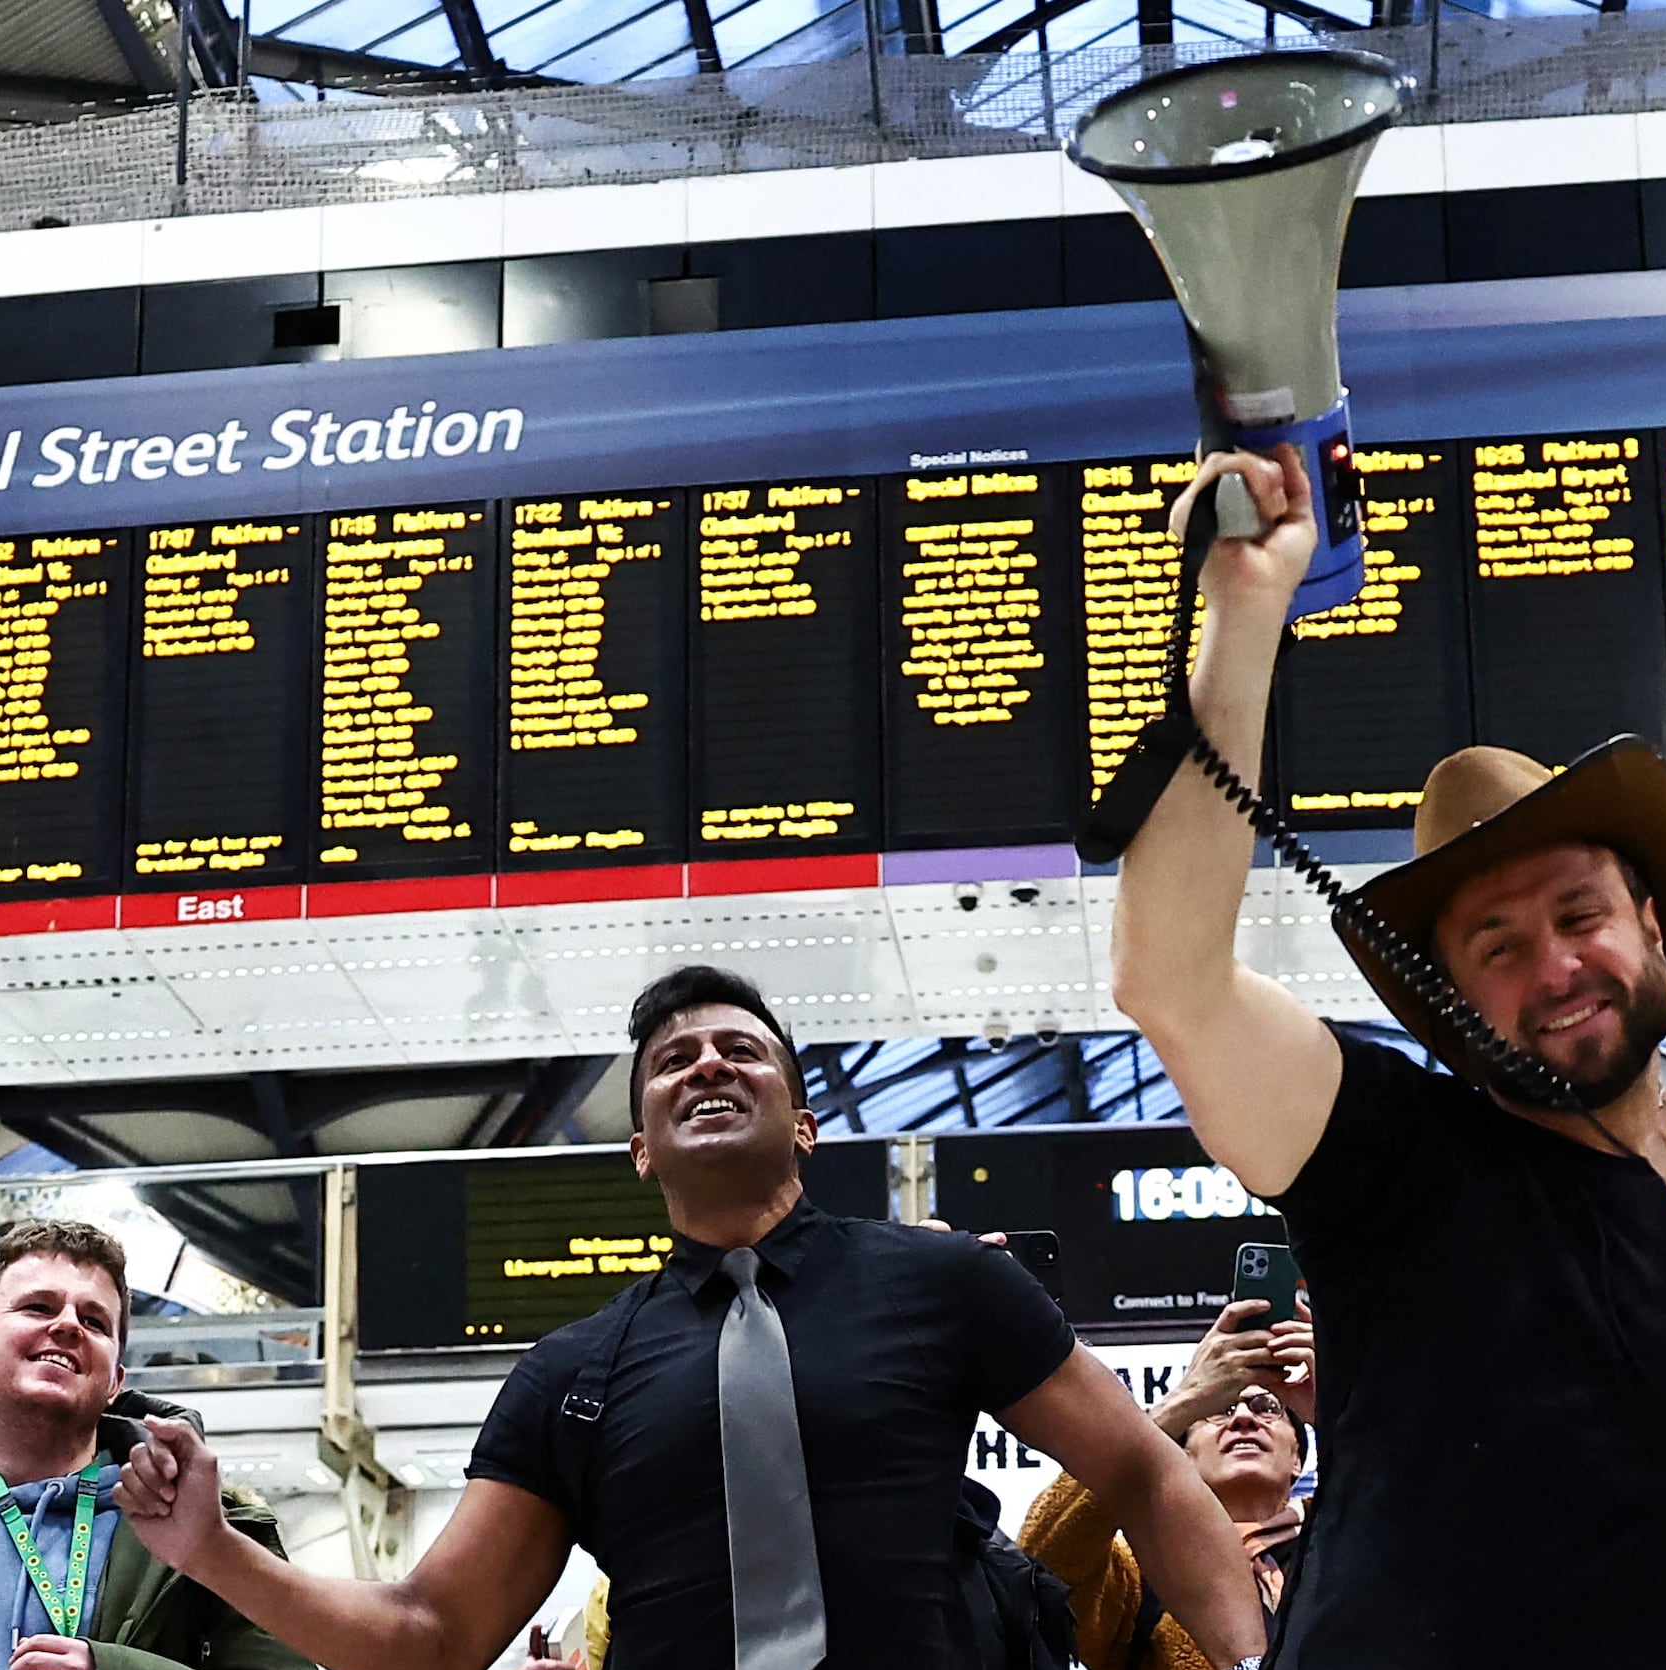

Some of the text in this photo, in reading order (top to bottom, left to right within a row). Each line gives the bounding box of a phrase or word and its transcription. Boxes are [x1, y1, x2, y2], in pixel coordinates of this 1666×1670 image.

[33, 432, 245, 489] Street
[256, 401, 526, 470] Station
[1543, 441, 1619, 462] Platform
[768, 486, 842, 507] Platform
[907, 476, 967, 501] Special
[580, 499, 653, 519] Platform
[393, 511, 465, 533] Platform
[212, 524, 282, 545] Platform
[32, 537, 101, 557] Platform
[177, 895, 243, 921] East
[1113, 1294, 1174, 1310] Connect
[1177, 1294, 1194, 1306] to
